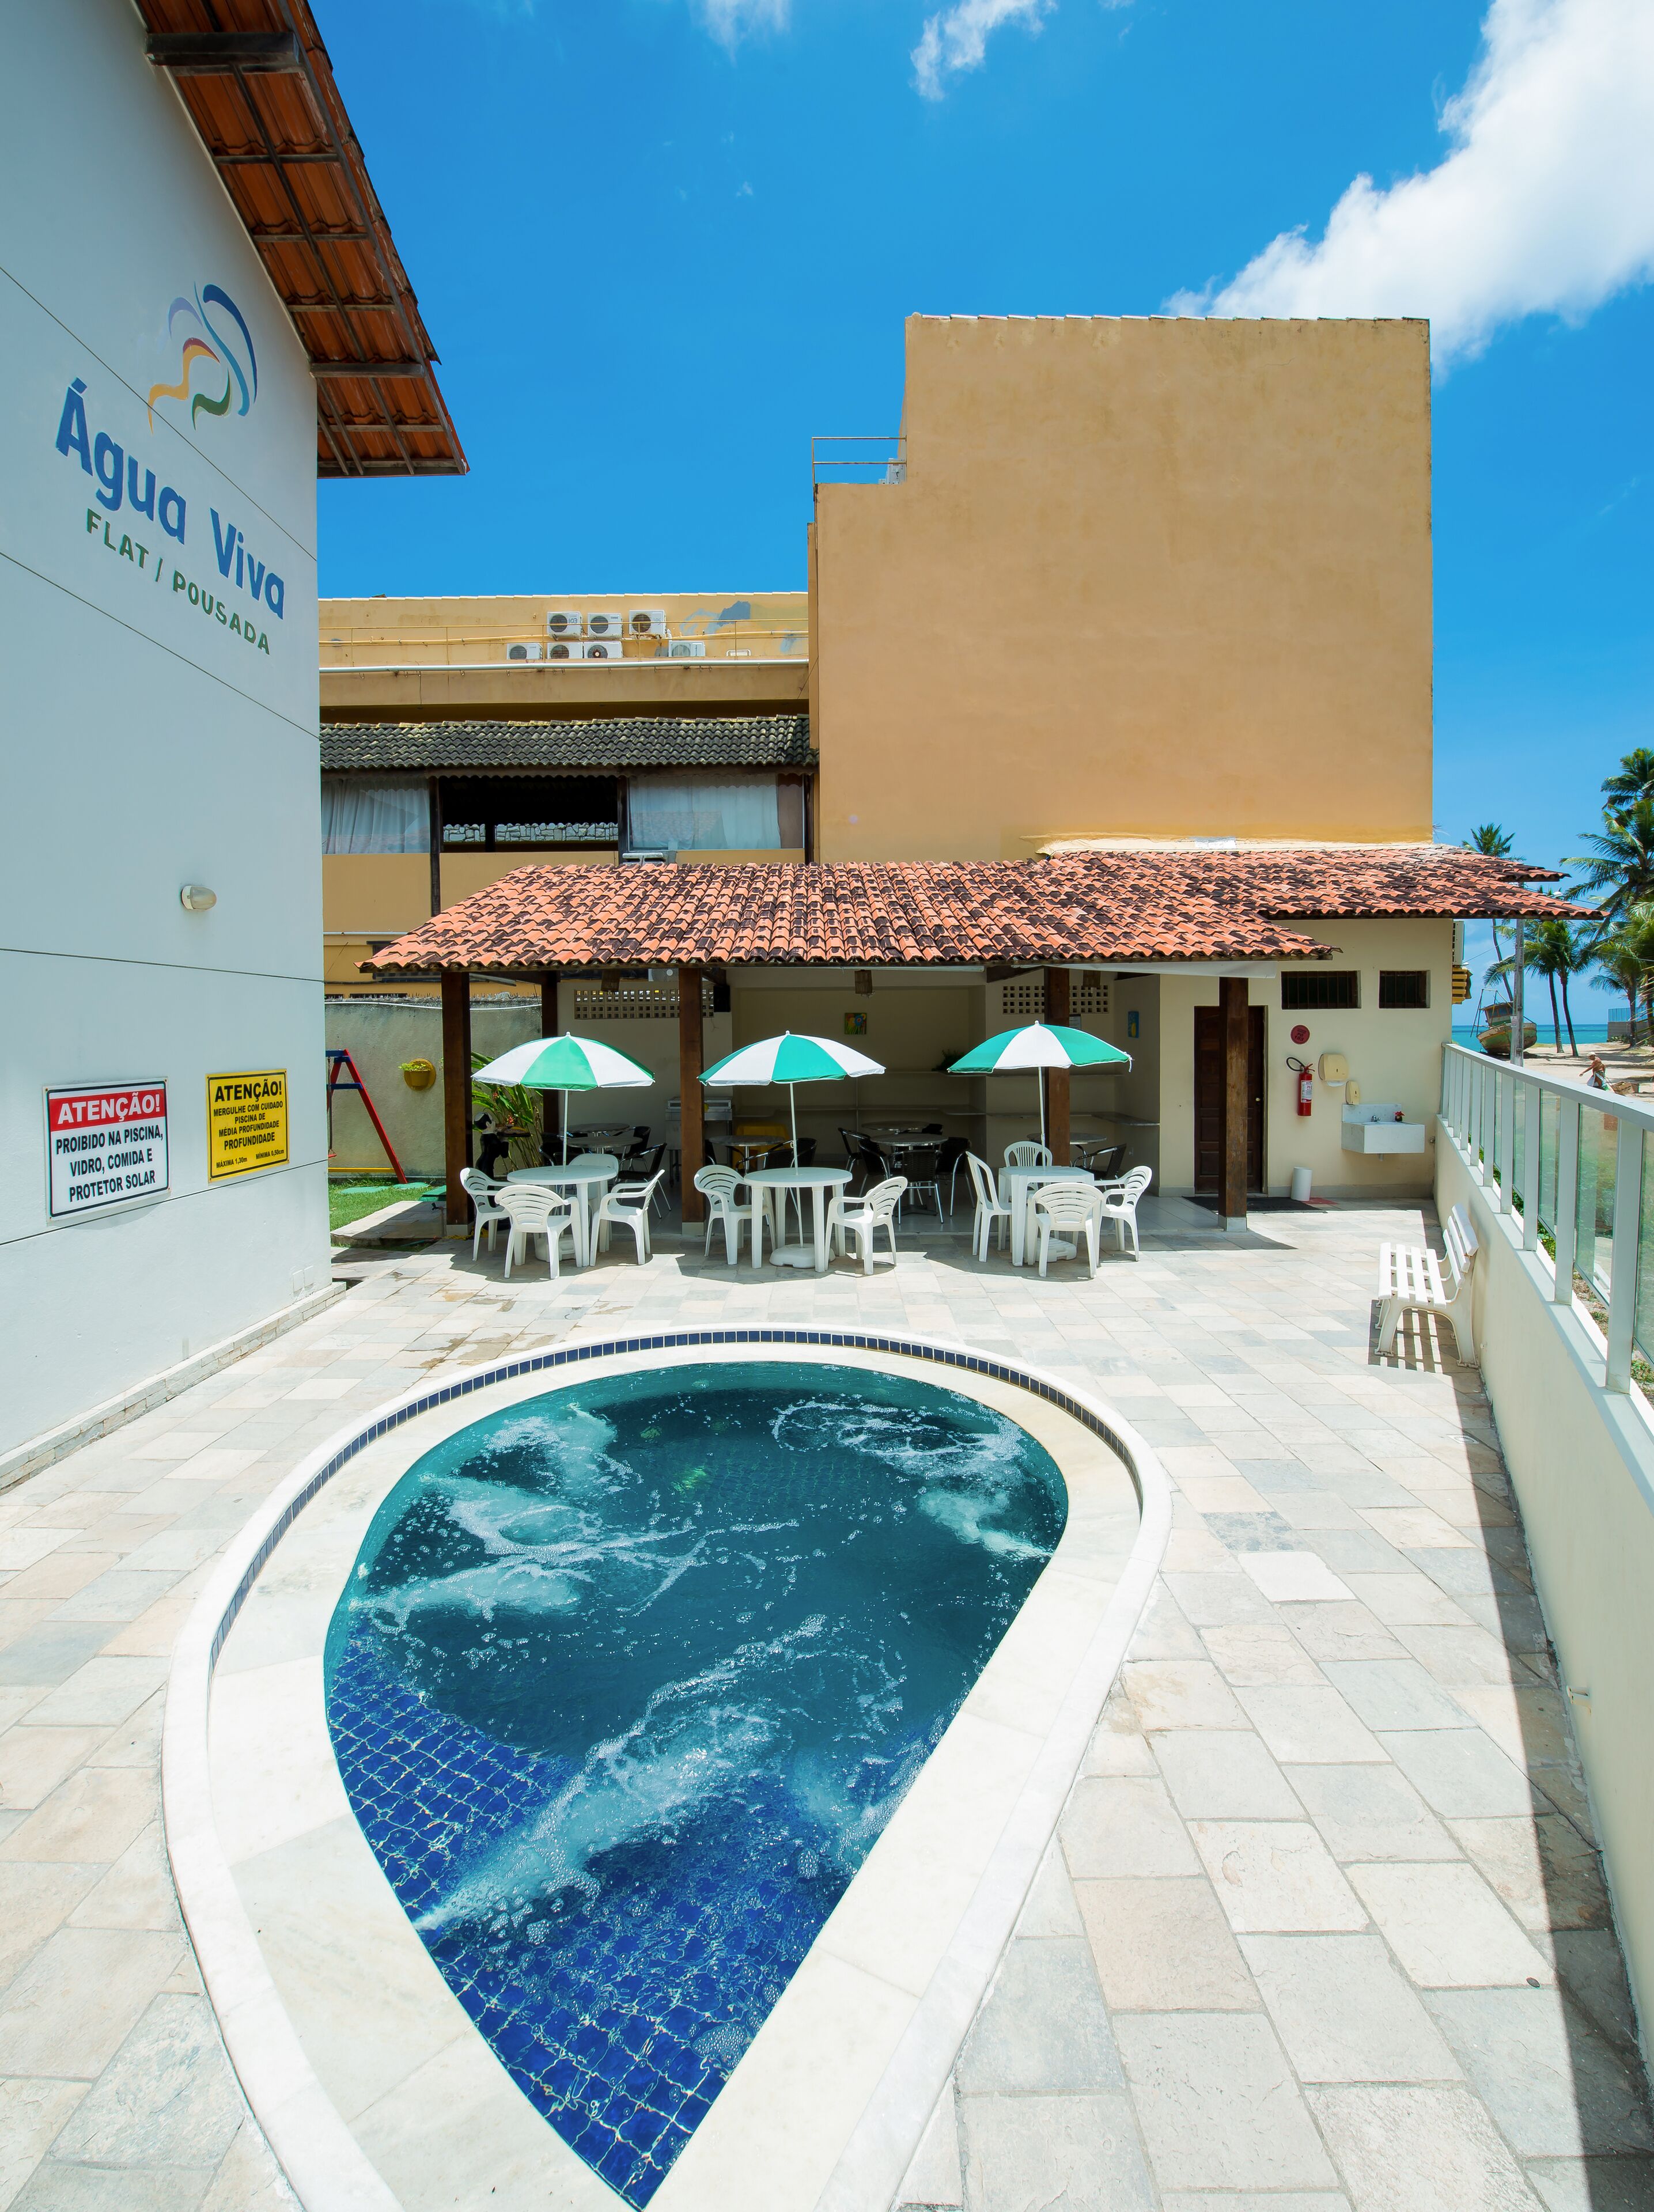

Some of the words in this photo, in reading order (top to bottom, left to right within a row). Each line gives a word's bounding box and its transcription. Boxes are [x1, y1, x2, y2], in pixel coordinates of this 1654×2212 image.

[55, 377, 187, 545] Água
[210, 507, 285, 620] Viva
[86, 507, 149, 569] FLAT
[154, 557, 164, 582] /
[173, 570, 271, 656] POUSADA
[214, 1078, 282, 1103] ATENÇÃO!
[58, 1092, 161, 1124] ATENÇÃO!
[214, 1105, 246, 1117] MERGULHE
[247, 1104, 260, 1112] COM
[260, 1100, 283, 1111] CUIDADO
[234, 1114, 258, 1124] PISCINA
[258, 1112, 266, 1121] DE
[56, 1132, 105, 1155] PROIBIDO
[108, 1130, 122, 1146] NA
[124, 1124, 163, 1143] PISCINA,
[219, 1127, 237, 1137] MÉDIA
[239, 1120, 279, 1134] PROFUNDIDADE
[224, 1132, 275, 1150] PROFUNDIDADE
[70, 1157, 105, 1177] VIDRO,
[108, 1149, 145, 1170] COMIDA
[147, 1148, 153, 1162] E
[216, 1159, 234, 1168] MÁXIMA
[235, 1157, 248, 1165] 1,30m
[255, 1150, 270, 1160] MÍNIMA
[271, 1149, 285, 1157] 0,50cm
[69, 1177, 123, 1202] PROTETOR
[126, 1170, 156, 1190] SOLAR
